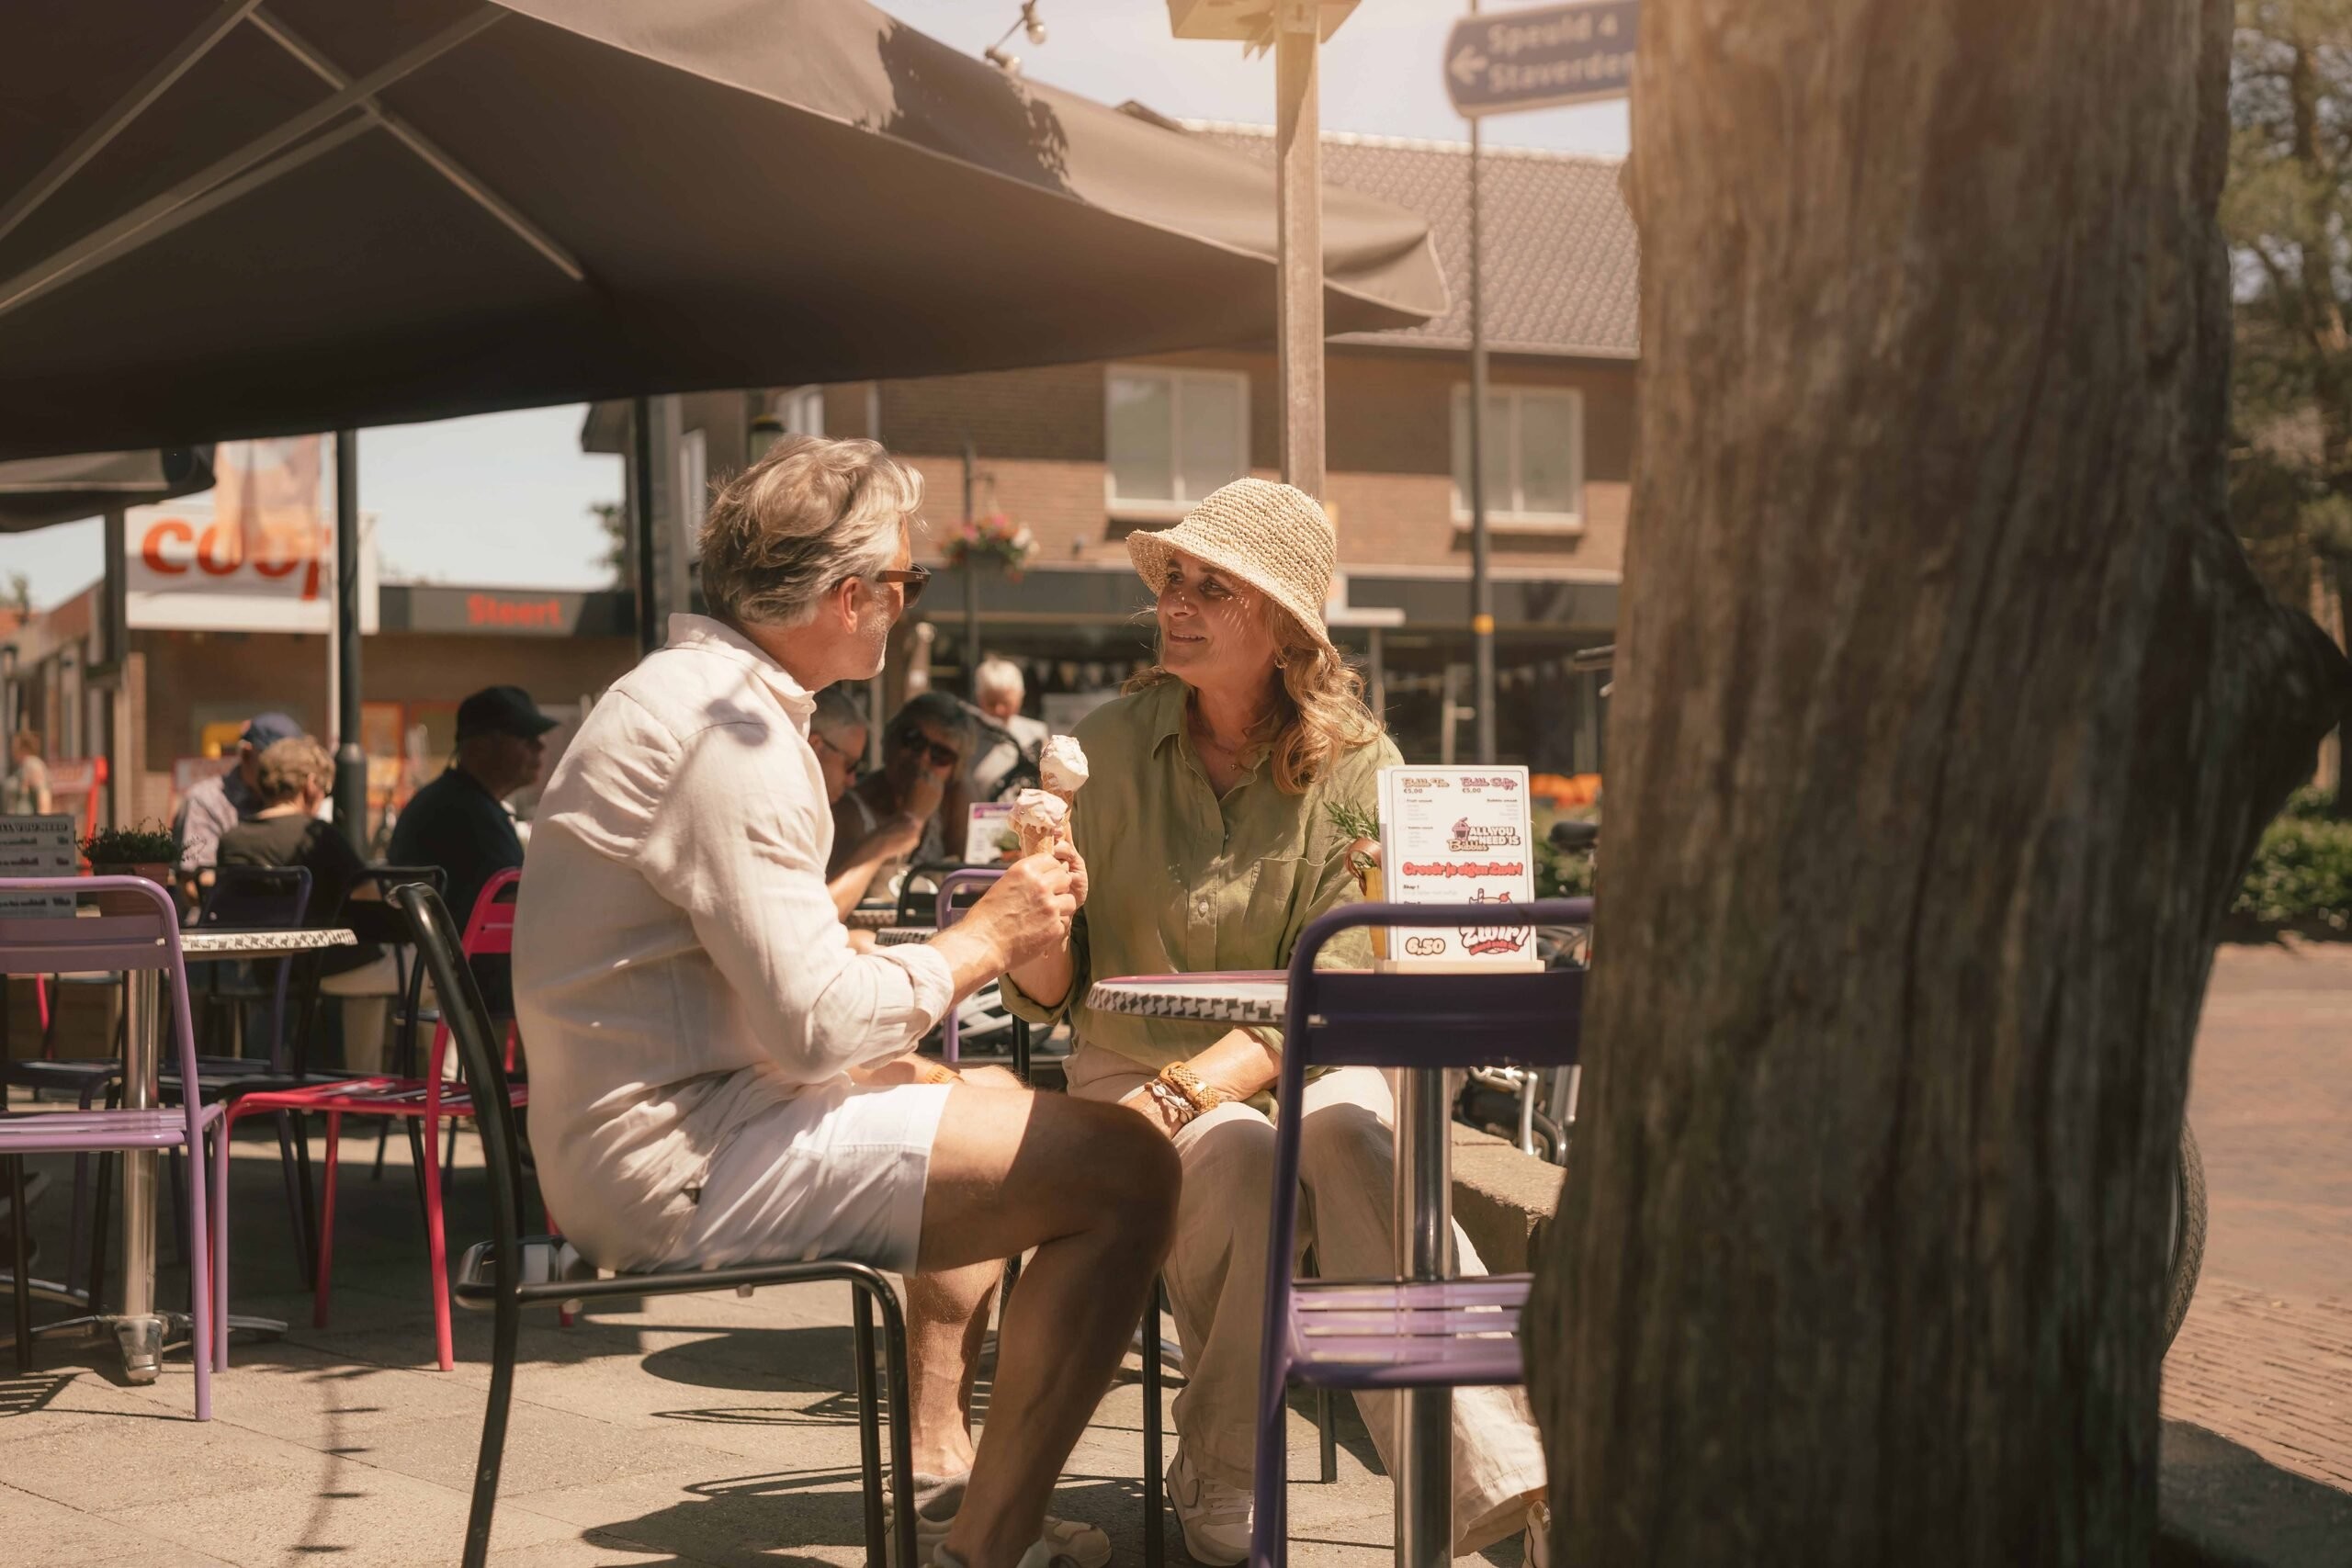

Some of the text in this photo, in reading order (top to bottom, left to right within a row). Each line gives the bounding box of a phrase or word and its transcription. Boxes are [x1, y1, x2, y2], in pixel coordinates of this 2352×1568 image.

[142, 520, 331, 602] co
[1469, 827, 1516, 837] ALL YOU
[1446, 839, 1489, 852] Bubbles
[1478, 836, 1521, 846] NEED IS
